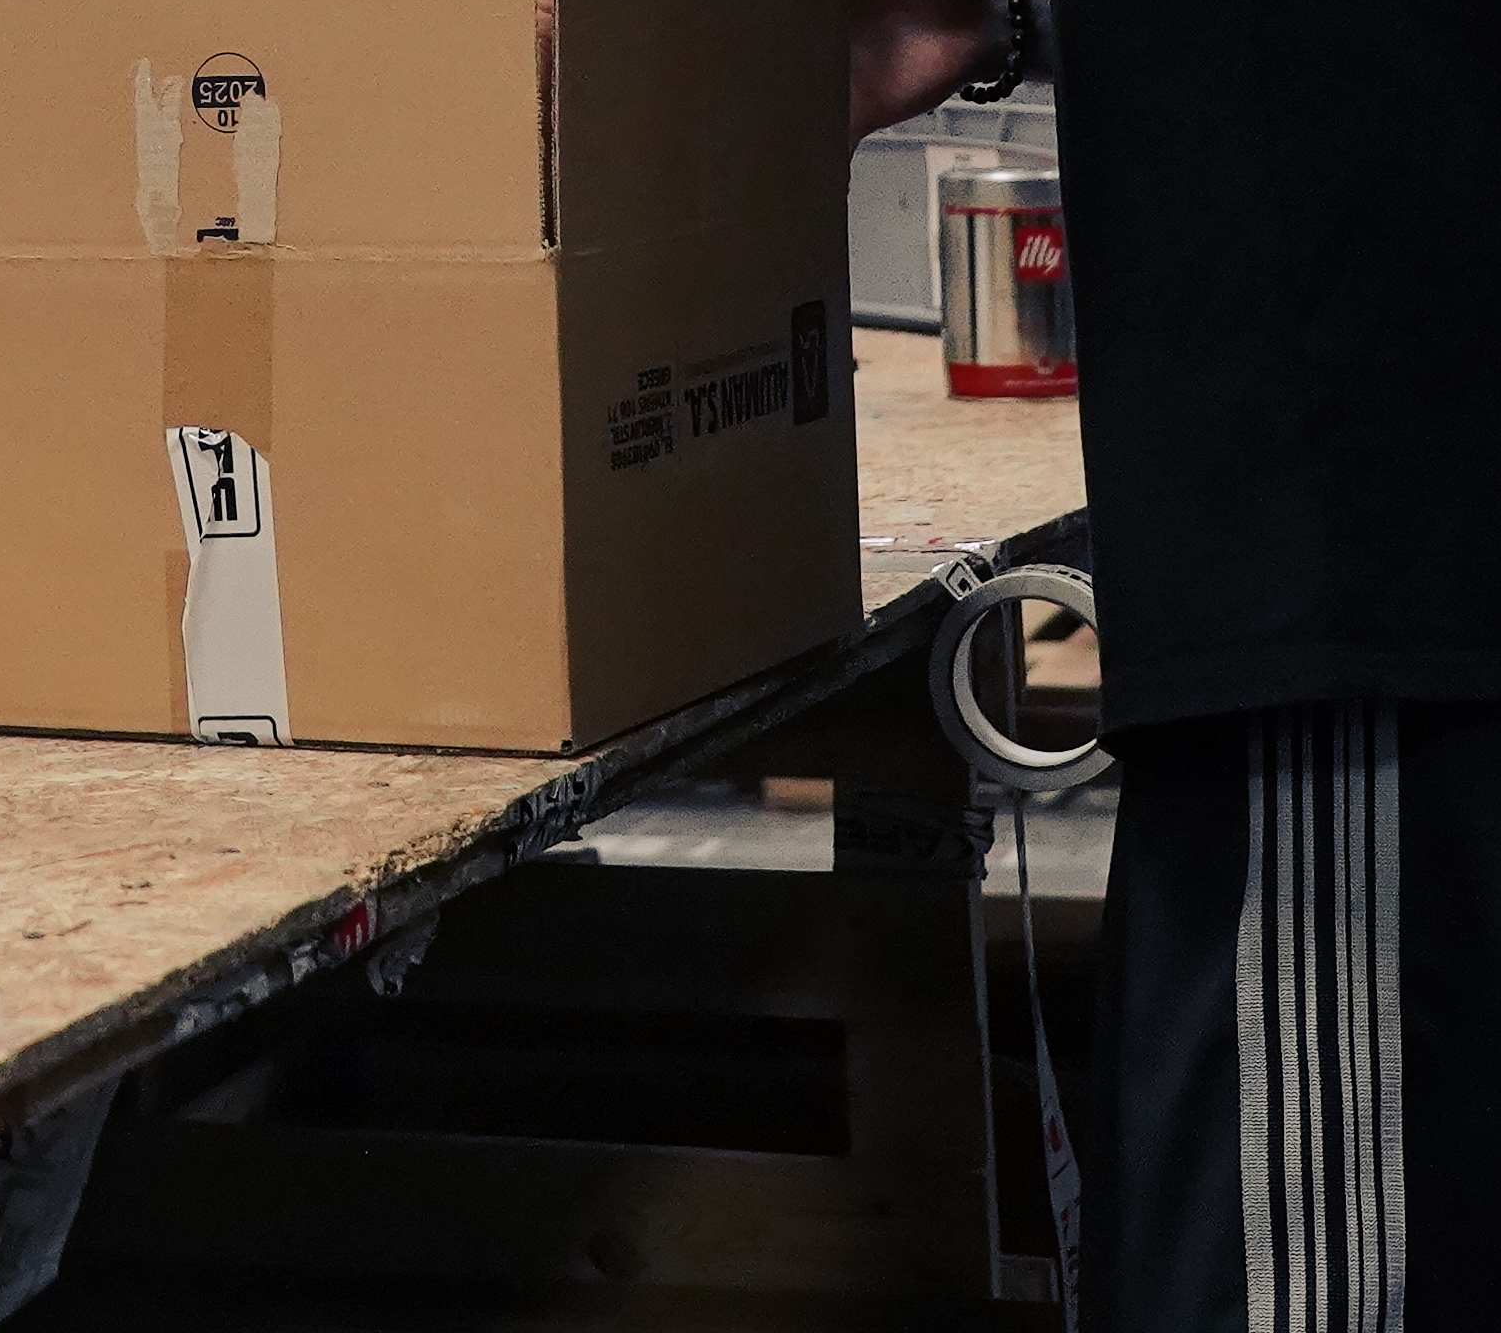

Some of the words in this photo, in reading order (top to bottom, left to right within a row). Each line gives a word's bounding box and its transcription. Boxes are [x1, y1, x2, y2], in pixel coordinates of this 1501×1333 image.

[199, 81, 258, 104] 2025
[218, 109, 239, 127] 10
[1019, 234, 1062, 275] illy
